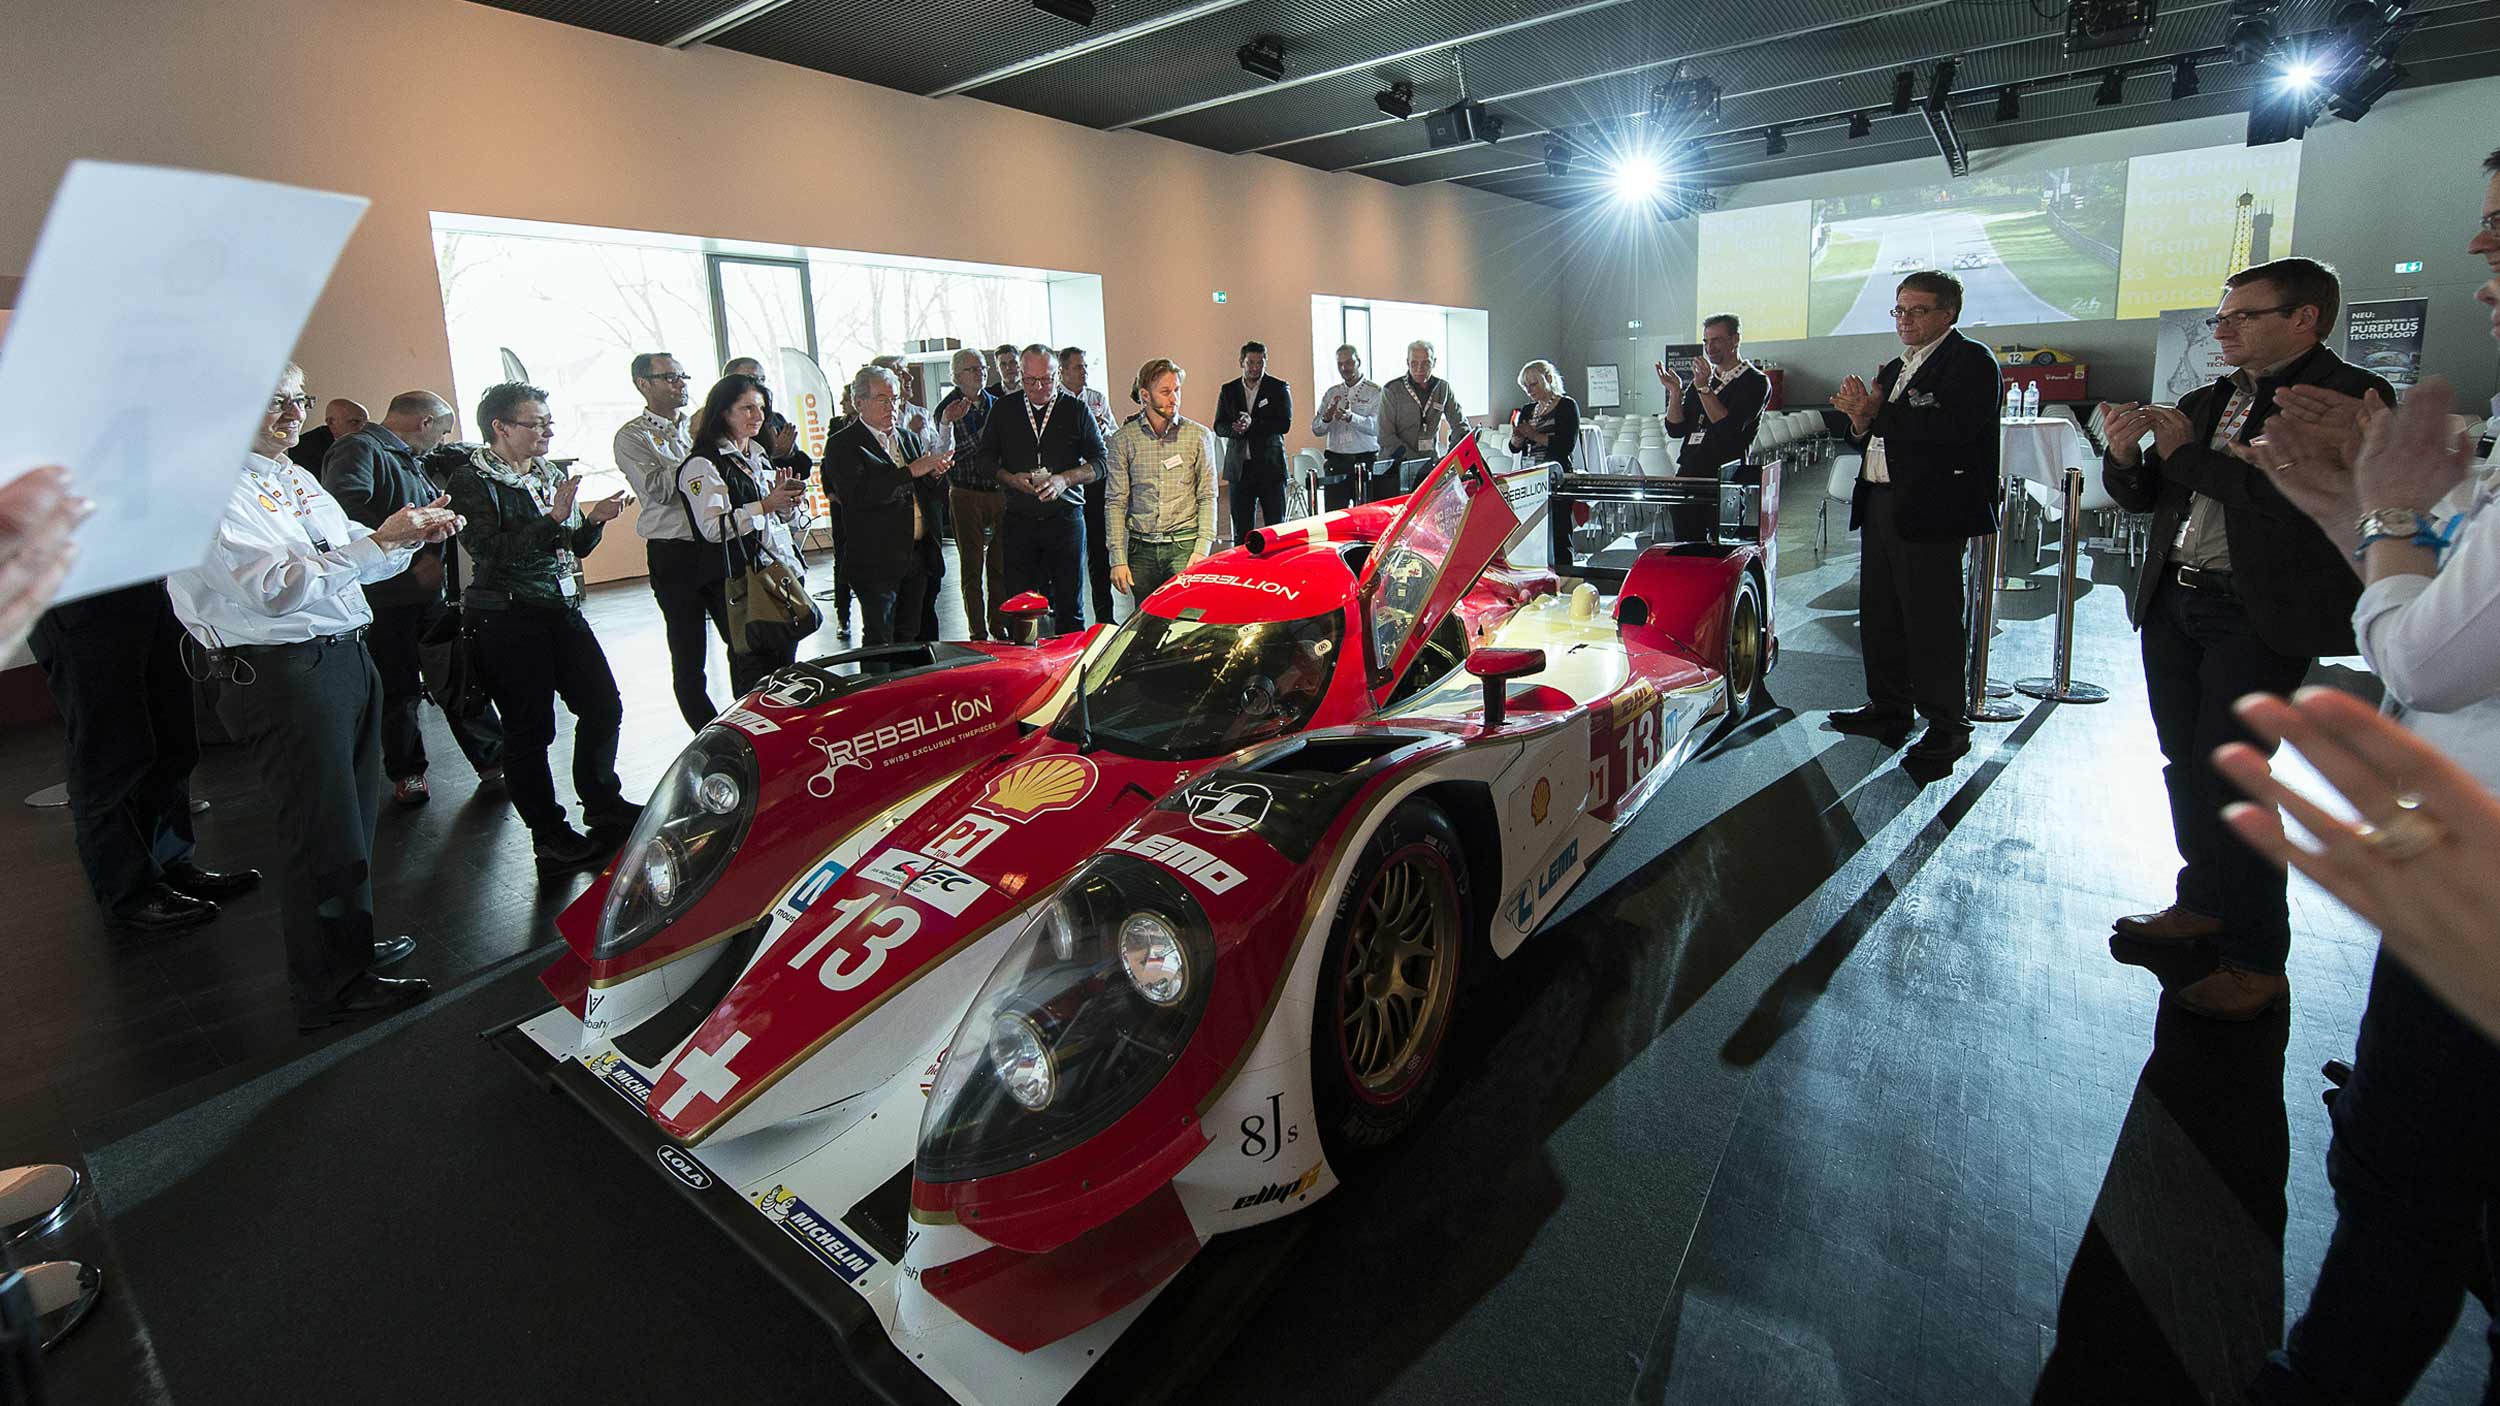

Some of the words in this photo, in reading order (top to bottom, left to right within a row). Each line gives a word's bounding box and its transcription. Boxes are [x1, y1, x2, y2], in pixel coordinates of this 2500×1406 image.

[2349, 321, 2419, 334] PUREPLUS
[2349, 330, 2418, 341] TECHNOLOGY
[2009, 351, 2023, 364] 12
[828, 695, 992, 767] REBELLION
[882, 753, 910, 767] SWISS
[912, 736, 958, 759] EXCLUSIVE
[957, 721, 998, 745] TIMEPIECES
[1619, 711, 1655, 790] 13
[930, 819, 994, 859] P1
[1104, 819, 1249, 896] LEMO
[1538, 837, 1578, 900] LEMO
[787, 892, 922, 992] 13
[661, 1149, 705, 1186] LOLA
[790, 1211, 870, 1273] MICHELIN
